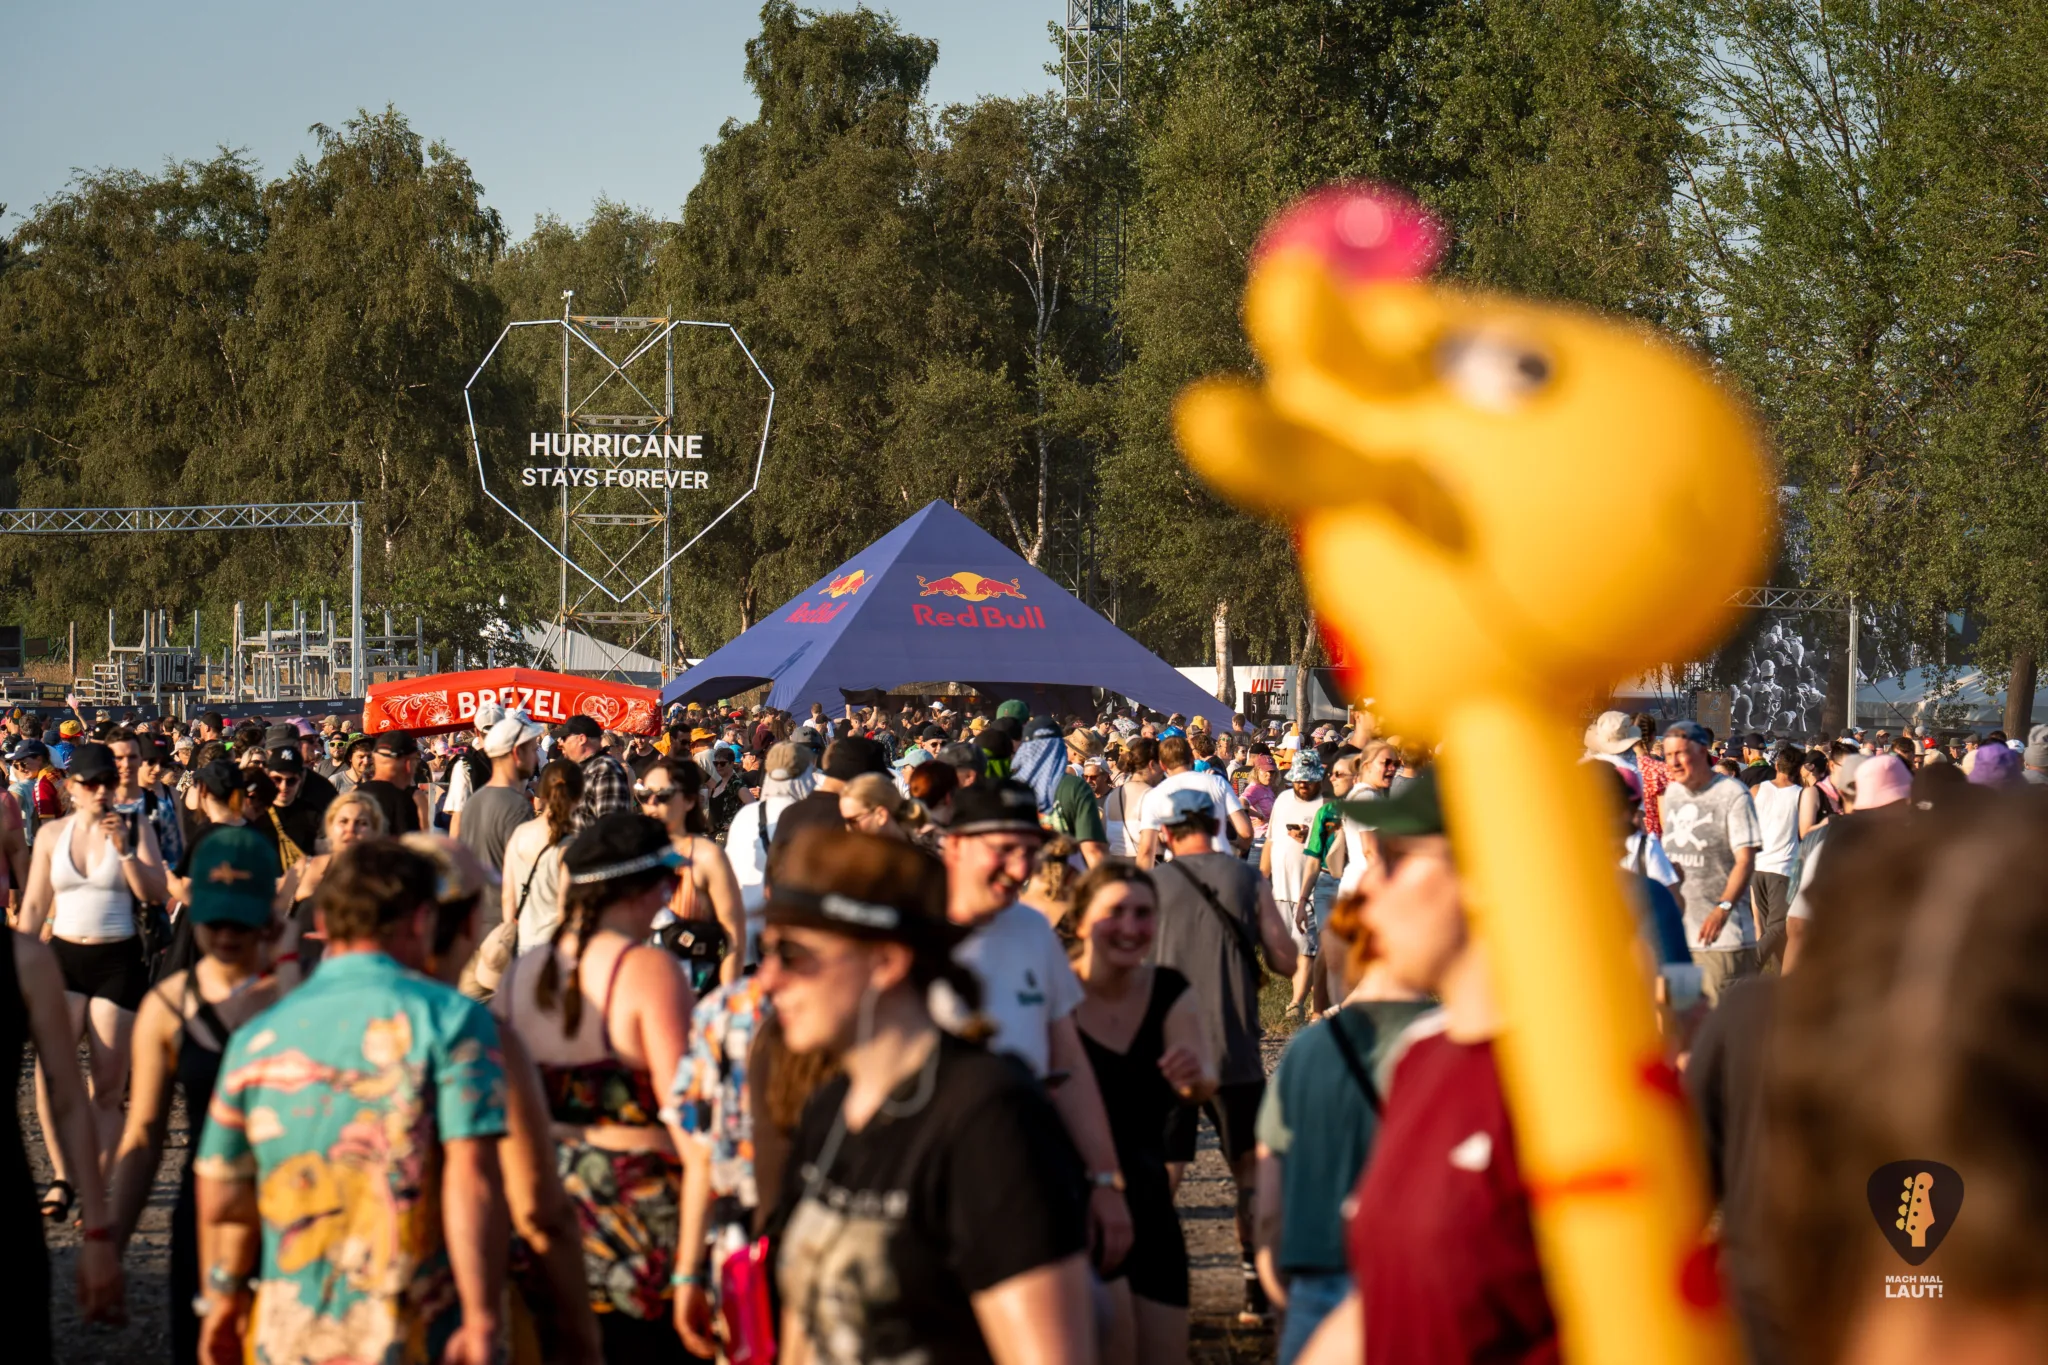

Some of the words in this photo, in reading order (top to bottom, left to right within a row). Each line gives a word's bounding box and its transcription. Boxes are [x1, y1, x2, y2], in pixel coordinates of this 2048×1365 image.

[530, 432, 703, 459] HURRICANE
[522, 467, 598, 487] STAYS
[605, 469, 709, 489] FOREVER
[911, 603, 979, 627] Red
[980, 605, 1047, 629] Bull
[457, 686, 567, 720] BREZEL
